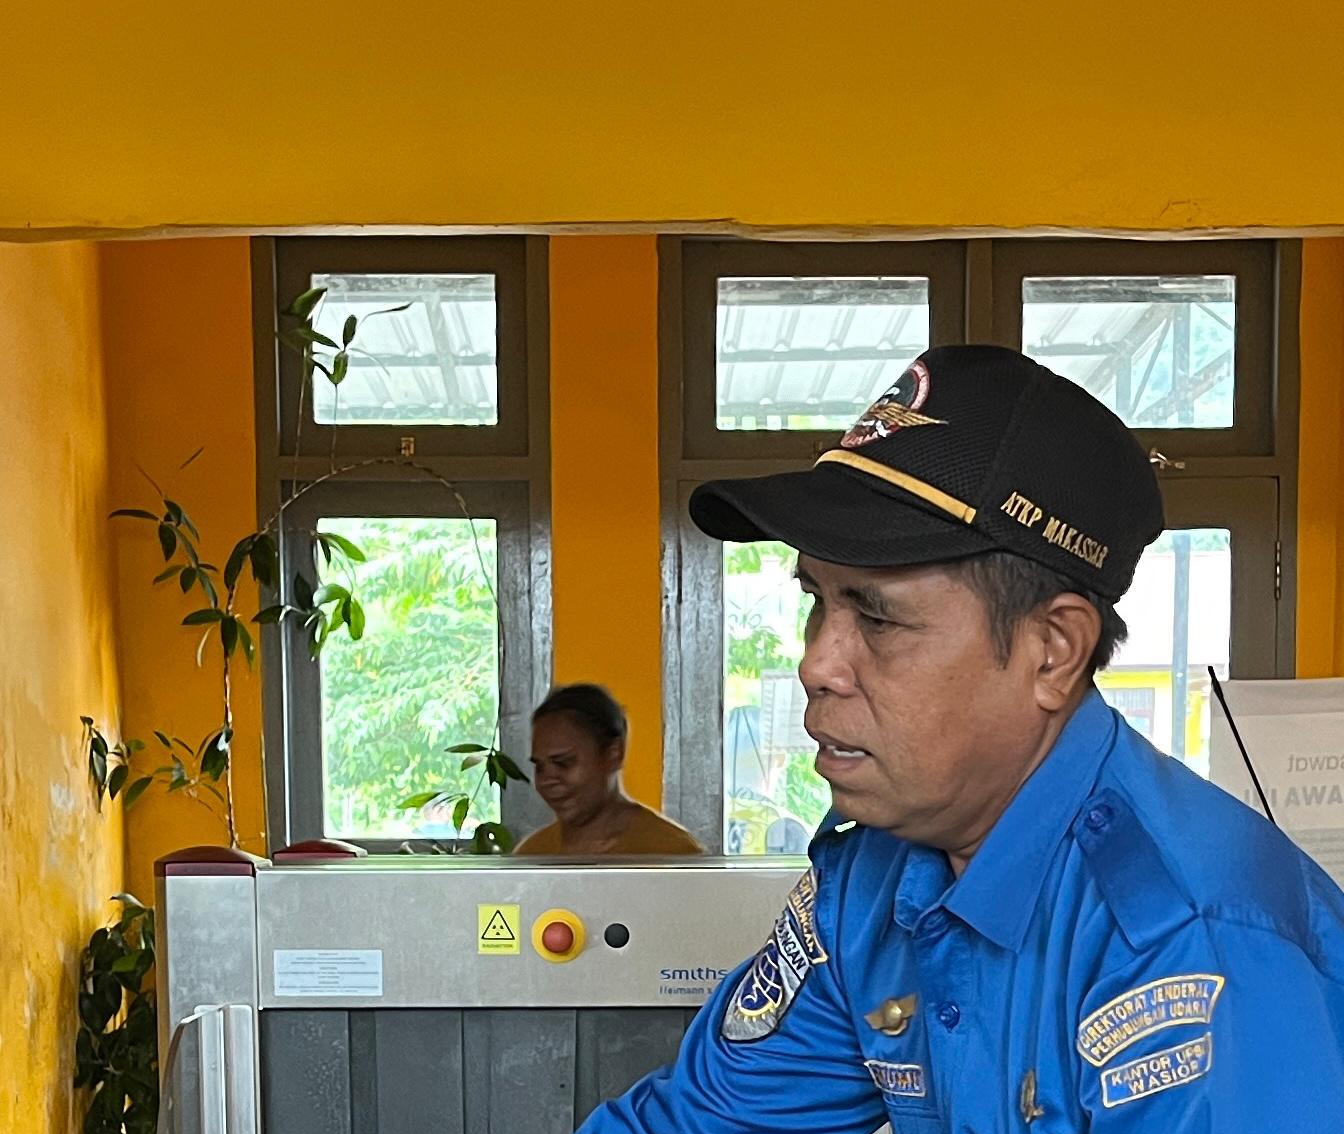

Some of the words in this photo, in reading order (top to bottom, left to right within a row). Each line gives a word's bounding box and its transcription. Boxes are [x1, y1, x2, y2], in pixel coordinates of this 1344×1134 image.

[1000, 491, 1043, 528] ATKP
[1042, 516, 1109, 569] MAKASSAR
[660, 967, 728, 980] smiths
[1111, 1055, 1171, 1087] KANTOR
[1128, 1059, 1199, 1095] WASIOR
